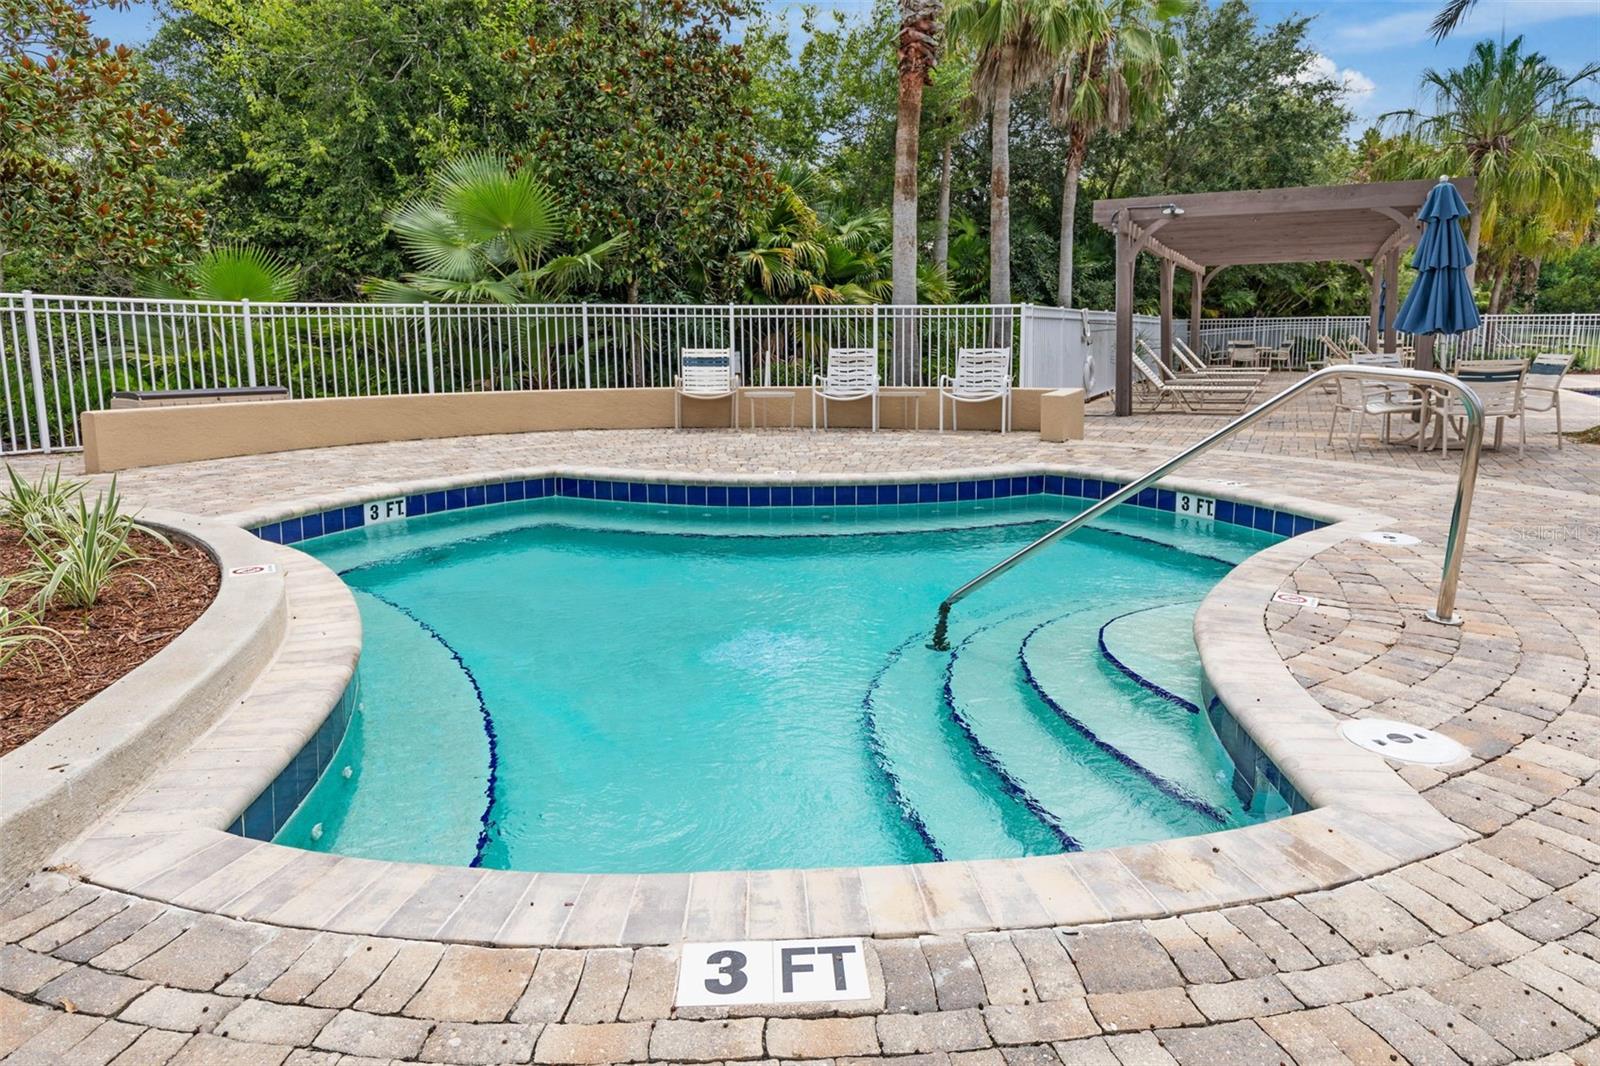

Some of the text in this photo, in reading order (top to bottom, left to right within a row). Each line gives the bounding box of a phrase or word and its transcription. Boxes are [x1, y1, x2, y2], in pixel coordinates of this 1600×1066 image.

[370, 500, 404, 520] 3 FT.
[1181, 496, 1214, 516] 3 FT.
[704, 945, 856, 995] 3 FT
